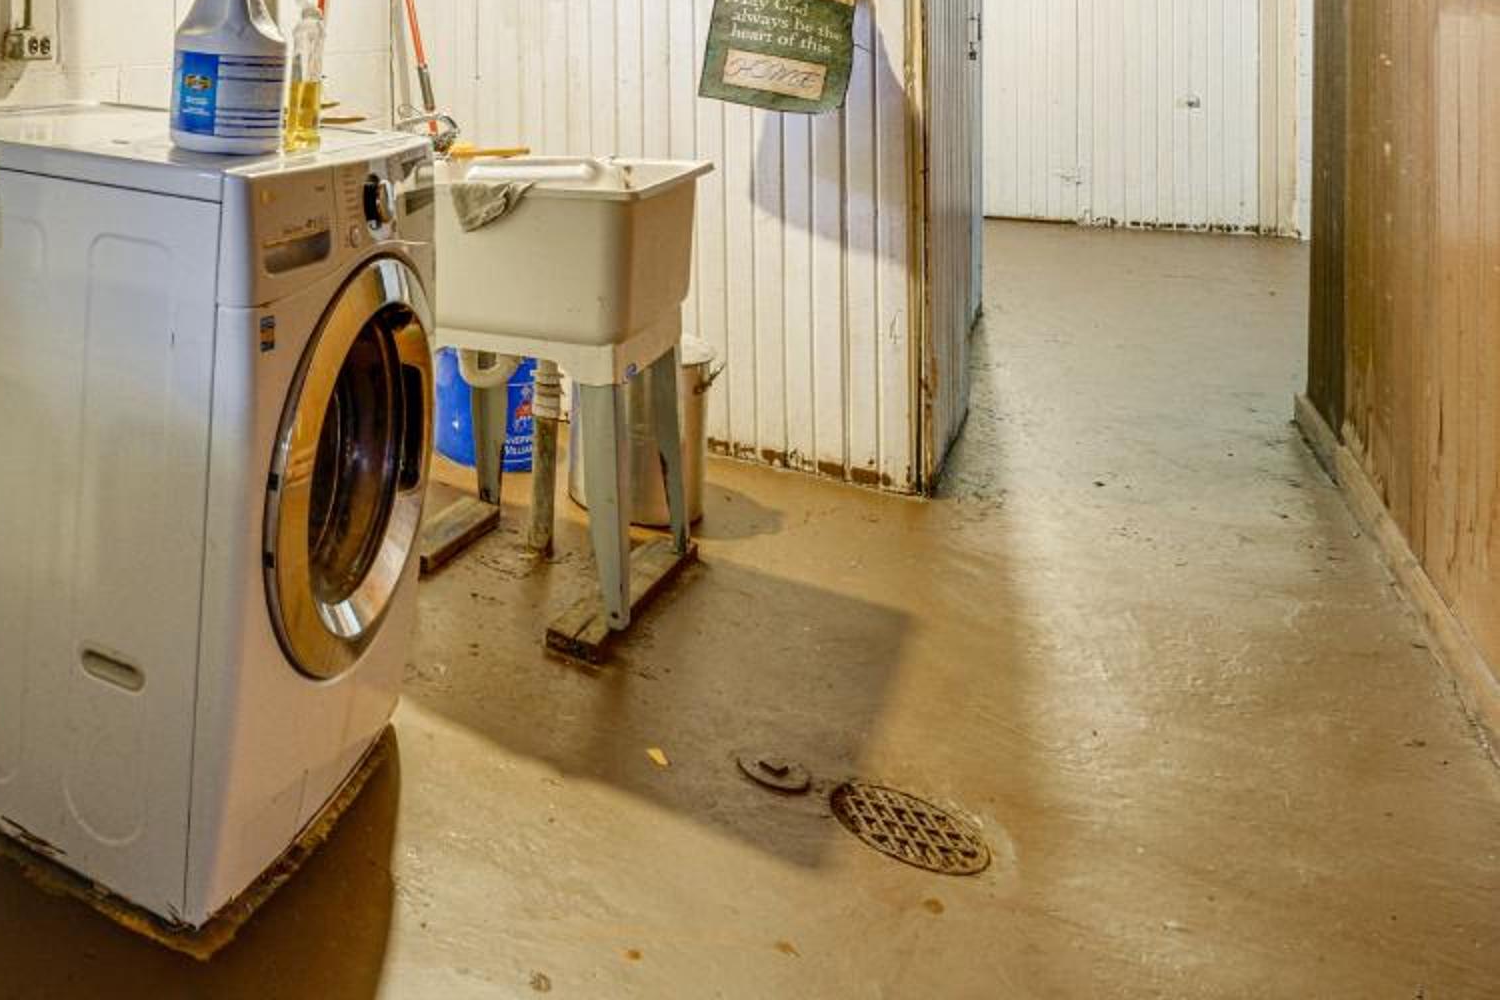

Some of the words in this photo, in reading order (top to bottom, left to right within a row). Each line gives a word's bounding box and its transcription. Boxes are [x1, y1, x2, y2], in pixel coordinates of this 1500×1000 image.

[731, 8, 790, 31] always
[795, 17, 813, 32] be
[731, 22, 773, 43] heart
[777, 32, 799, 47] of
[800, 37, 832, 54] this
